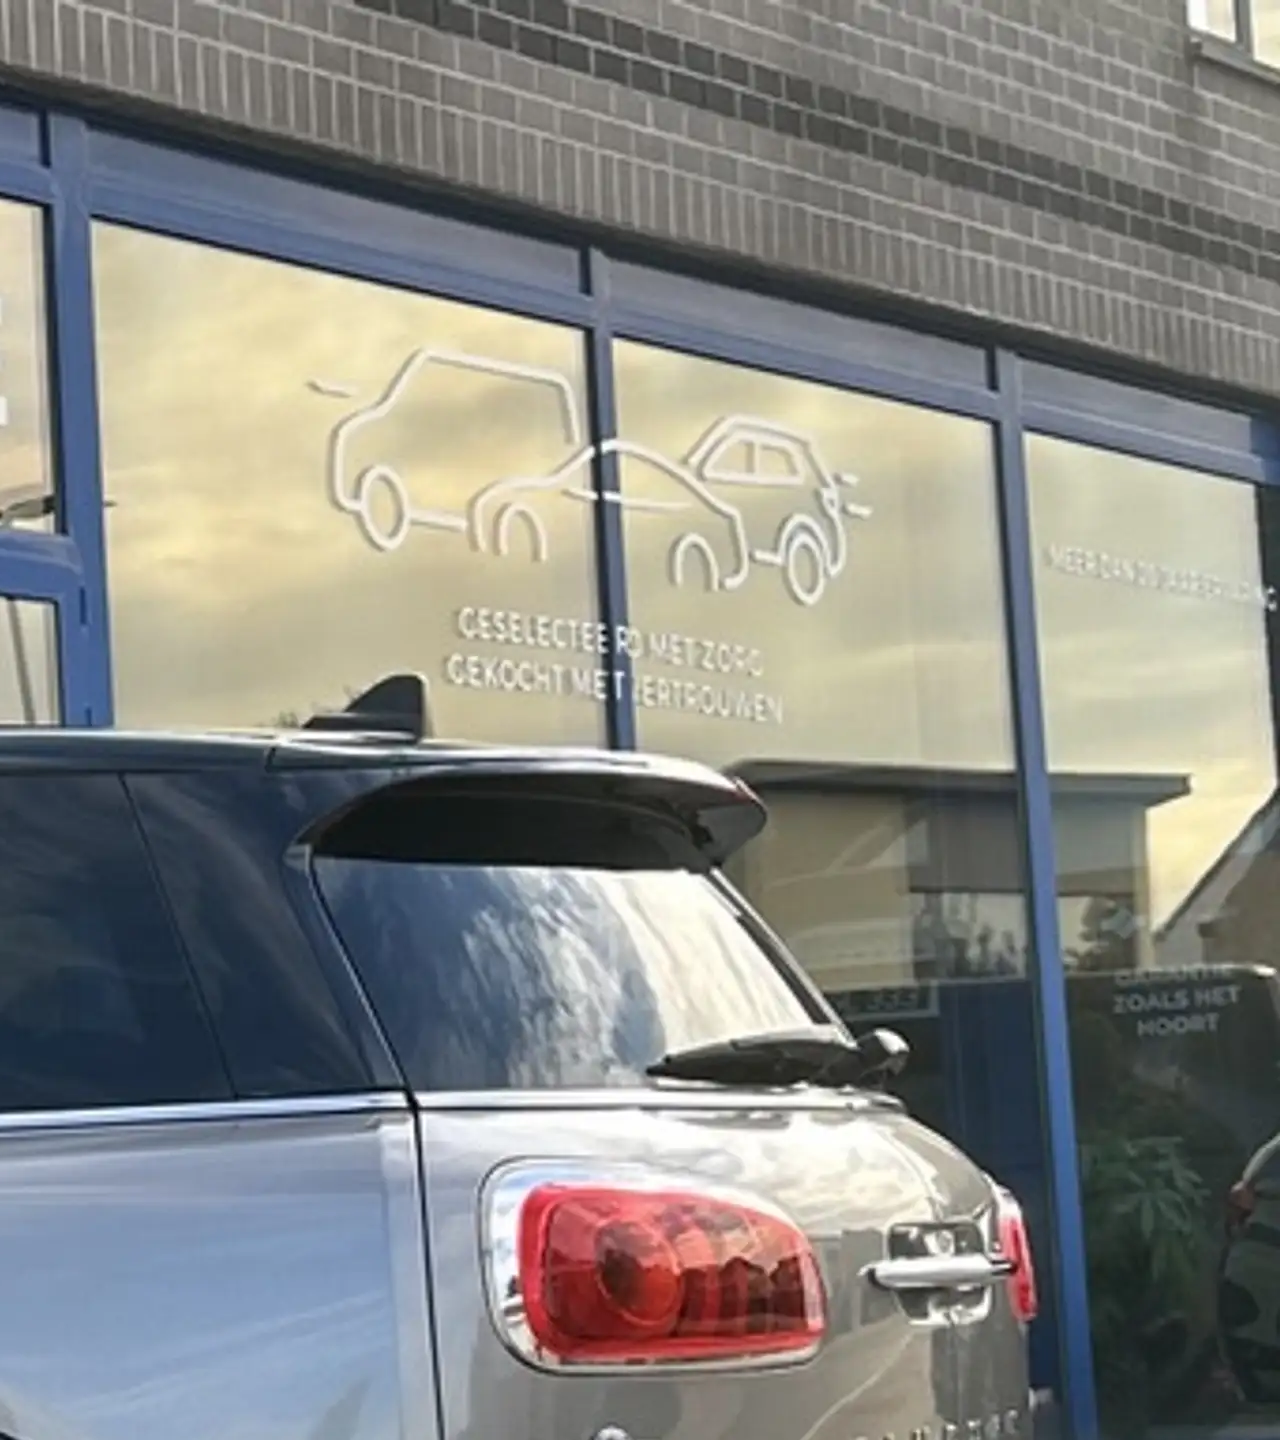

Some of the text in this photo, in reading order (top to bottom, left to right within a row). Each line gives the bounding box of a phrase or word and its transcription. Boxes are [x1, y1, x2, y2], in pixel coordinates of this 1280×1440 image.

[457, 605, 643, 660] GESELECTEERD
[444, 652, 564, 695] GEKOCHT
[570, 668, 626, 702] MET
